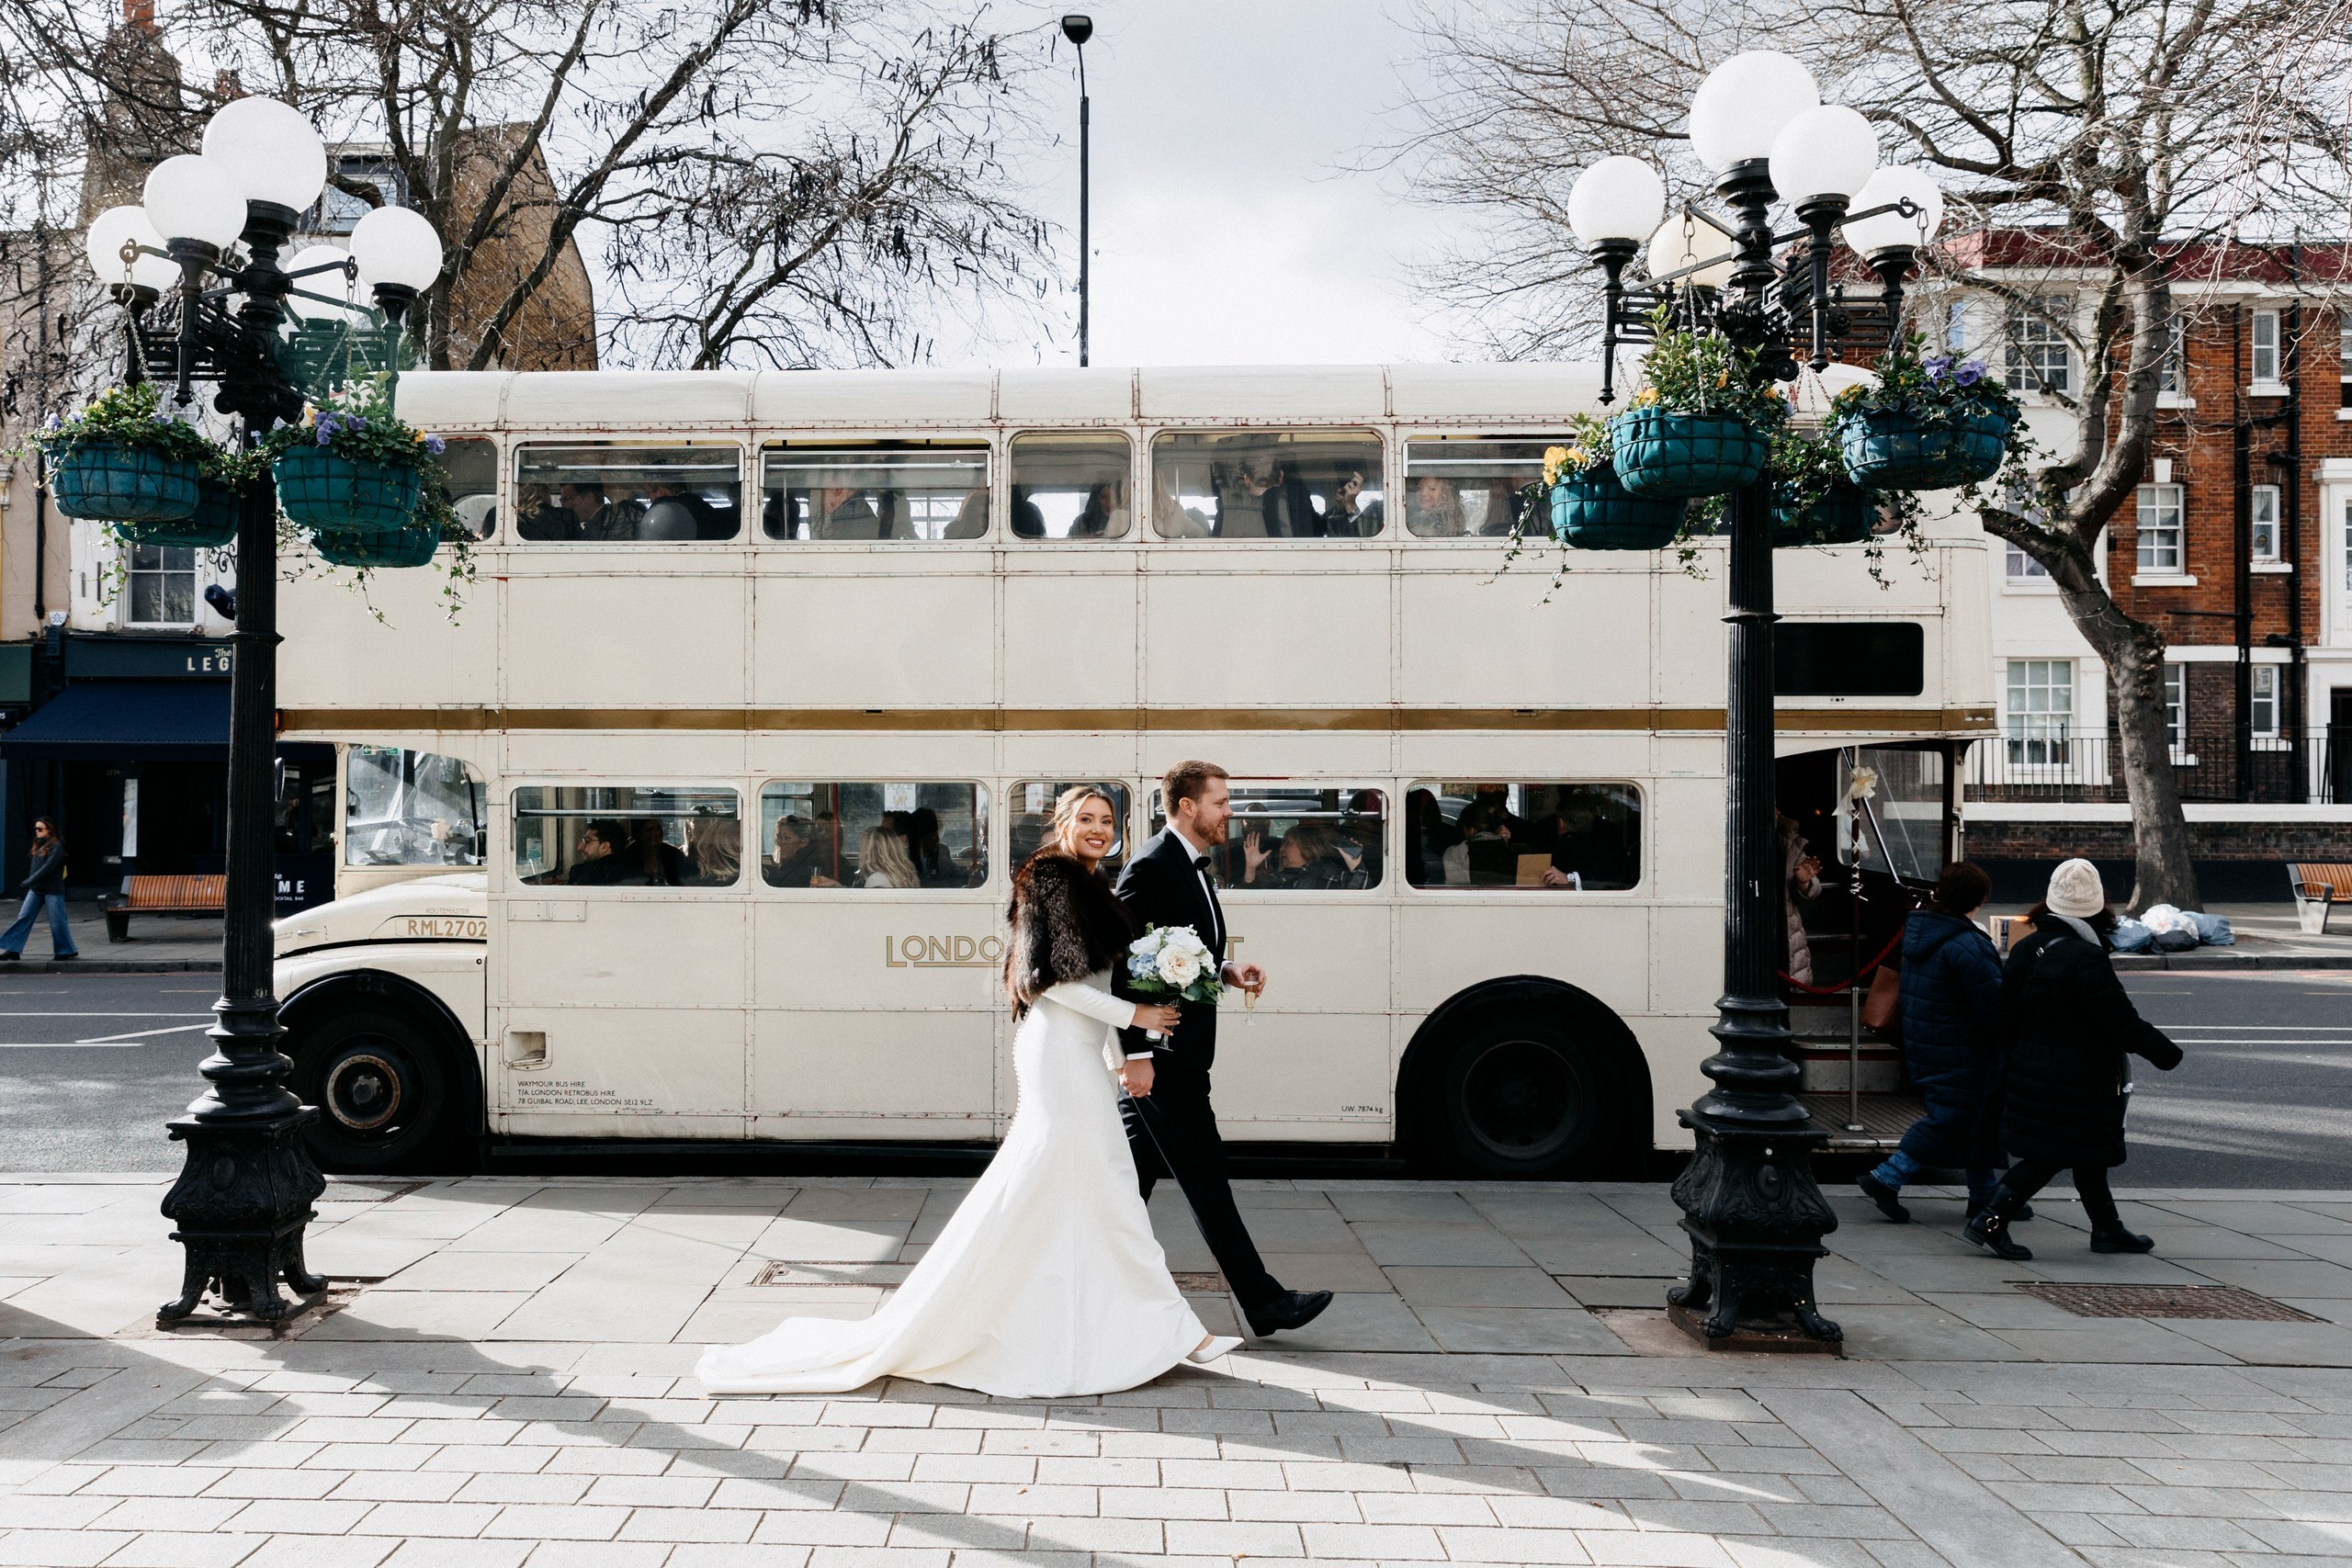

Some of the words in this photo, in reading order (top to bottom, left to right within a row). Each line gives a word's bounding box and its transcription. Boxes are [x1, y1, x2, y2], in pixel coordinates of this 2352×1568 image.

[214, 648, 232, 658] The
[187, 657, 230, 671] LEG
[278, 880, 305, 894] ME
[408, 919, 487, 937] RML2702
[887, 935, 1004, 967] LONDO
[1374, 1106, 1384, 1114] kg
